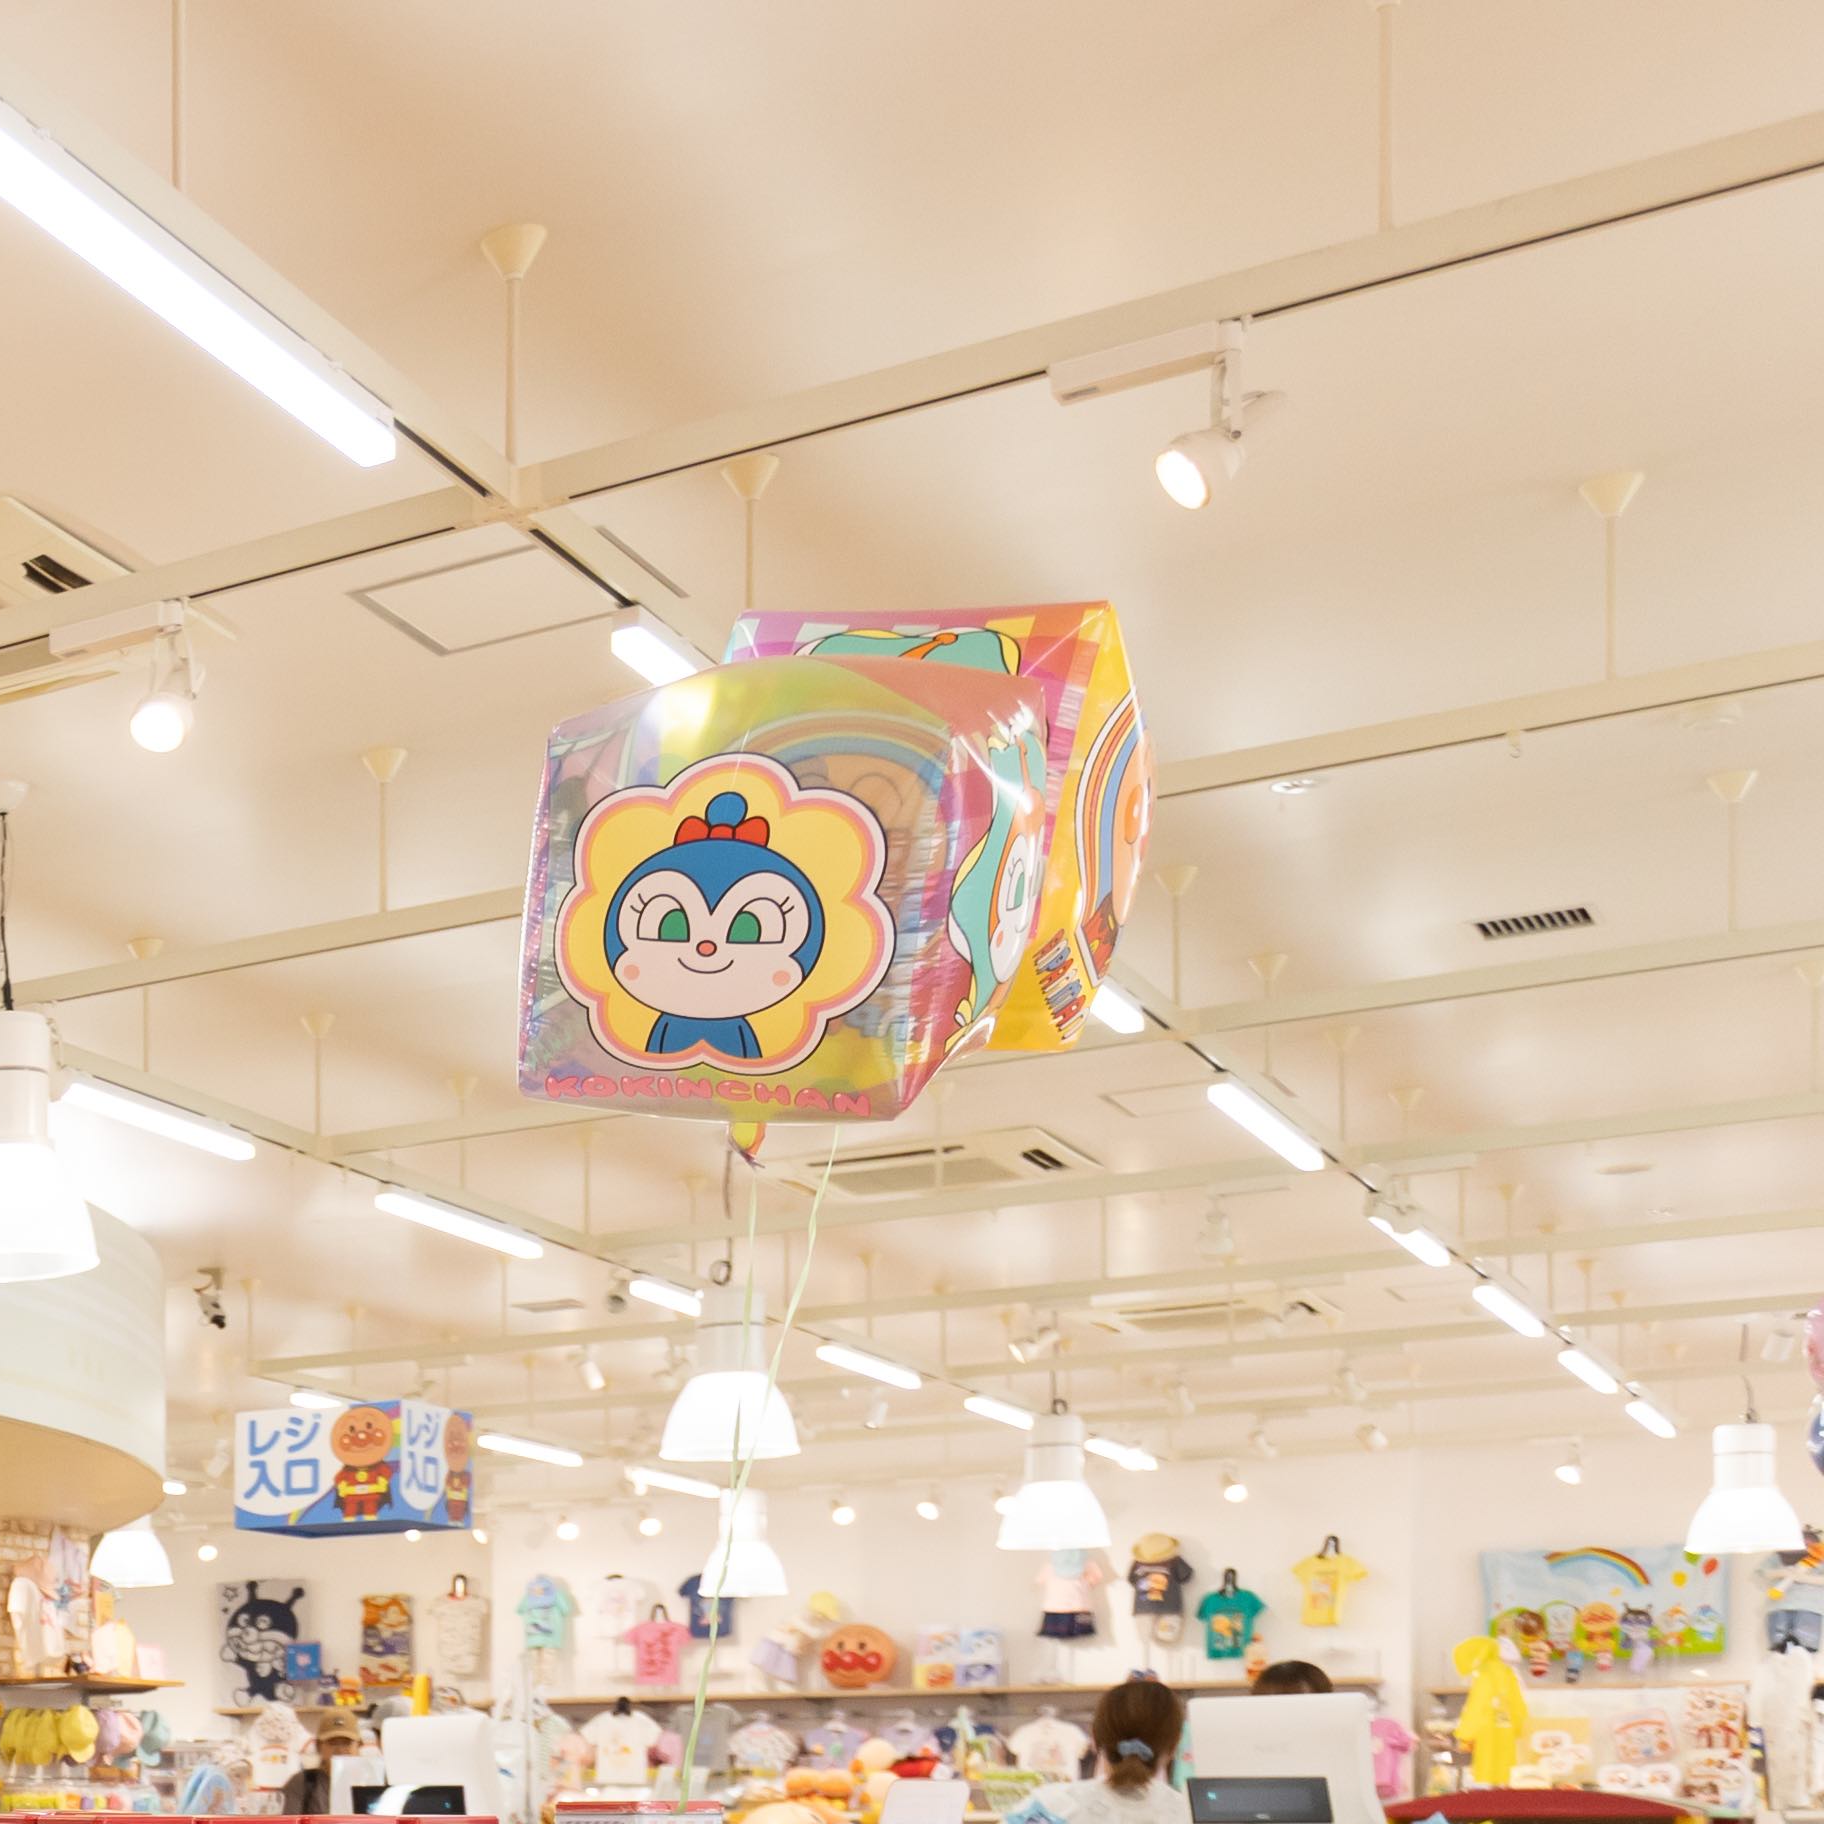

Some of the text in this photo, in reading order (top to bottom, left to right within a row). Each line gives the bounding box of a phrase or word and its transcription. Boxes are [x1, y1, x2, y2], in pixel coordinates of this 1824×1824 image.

[544, 1075, 872, 1117] KOKINCHAN
[248, 1413, 322, 1456] レジ
[407, 1408, 441, 1449] レジ
[244, 1458, 320, 1499] 入口
[405, 1450, 439, 1493] 入口
